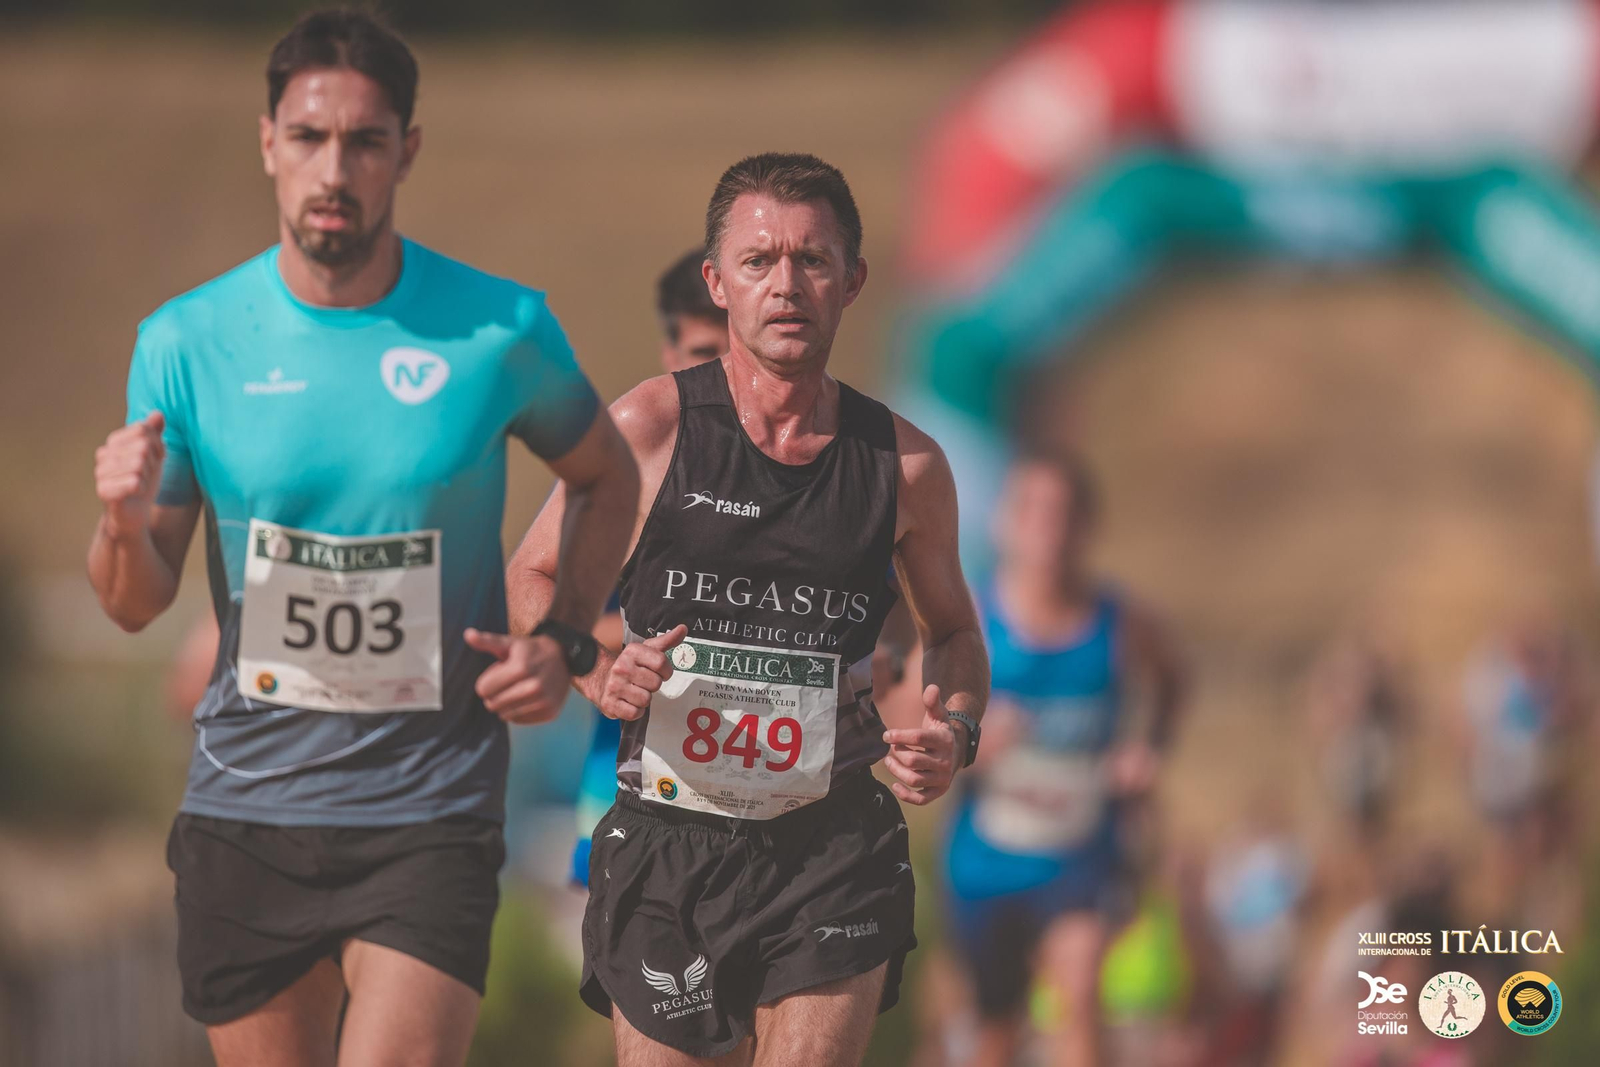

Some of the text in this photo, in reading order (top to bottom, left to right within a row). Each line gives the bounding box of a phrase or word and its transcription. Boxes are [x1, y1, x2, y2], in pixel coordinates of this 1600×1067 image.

[395, 361, 437, 388] NF
[715, 499, 760, 518] rasán
[662, 569, 869, 622] PEGASUS
[283, 595, 405, 655] 503
[693, 618, 787, 642] ATHLETIC
[708, 651, 793, 678] ITÁLICA
[699, 690, 796, 707] PEGASUS ATHLETIC CLUB
[715, 683, 781, 697] SVEN VAN BOVEN
[682, 707, 803, 772] 849
[666, 1003, 712, 1020] ATHLETIC CLUB
